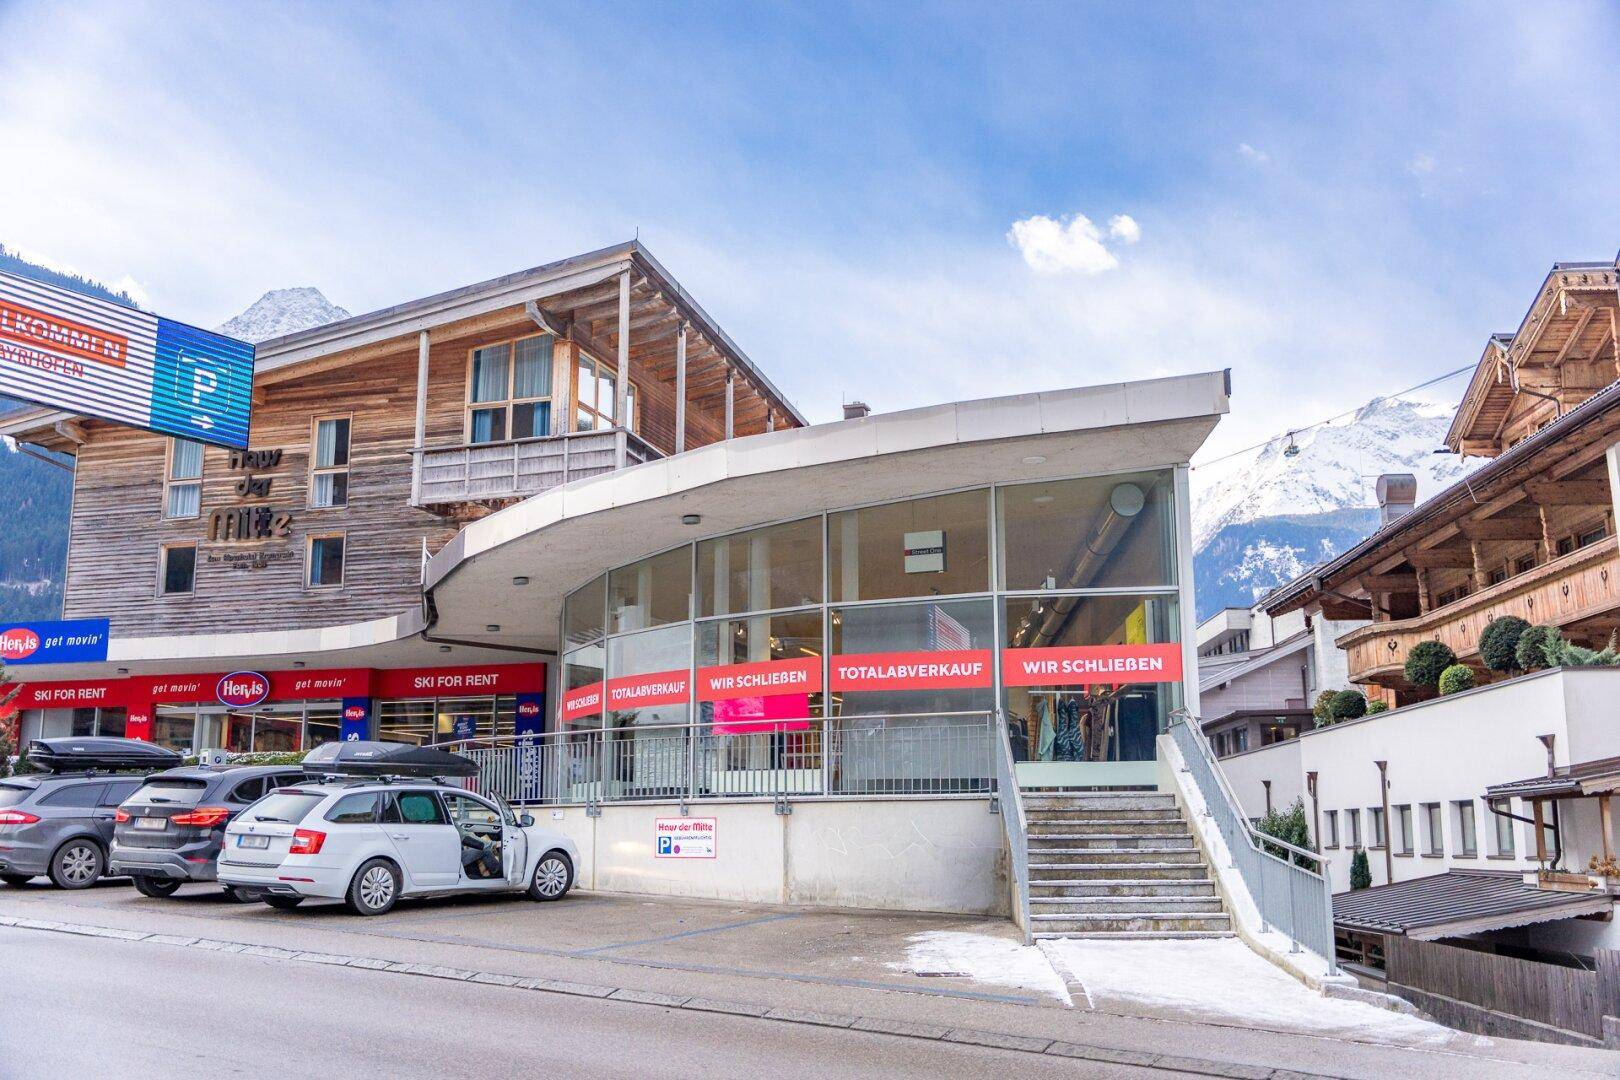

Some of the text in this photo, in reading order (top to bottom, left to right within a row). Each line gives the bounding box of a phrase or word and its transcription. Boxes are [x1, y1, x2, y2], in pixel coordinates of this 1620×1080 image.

[228, 449, 283, 469] Haus
[235, 473, 272, 496] der
[207, 507, 293, 540] Mitte
[0, 634, 37, 653] Hervis
[45, 634, 102, 649] get movin'
[838, 662, 983, 680] TOTALABVERKAUF
[1022, 660, 1059, 675] WIR
[295, 678, 346, 690] get movin'
[414, 674, 499, 688] SKI FOR RENT
[710, 677, 734, 690] WIR
[34, 688, 107, 701] SKI FOR RENT
[153, 682, 201, 695] get movin'
[223, 680, 264, 699] Hervis
[611, 680, 686, 701] TOTALABVERKAUF
[519, 704, 540, 714] Hervis
[566, 700, 576, 711] WIR
[130, 714, 148, 723] Hervis
[345, 708, 365, 718] Hervis
[658, 822, 713, 832] Haus der Mitte
